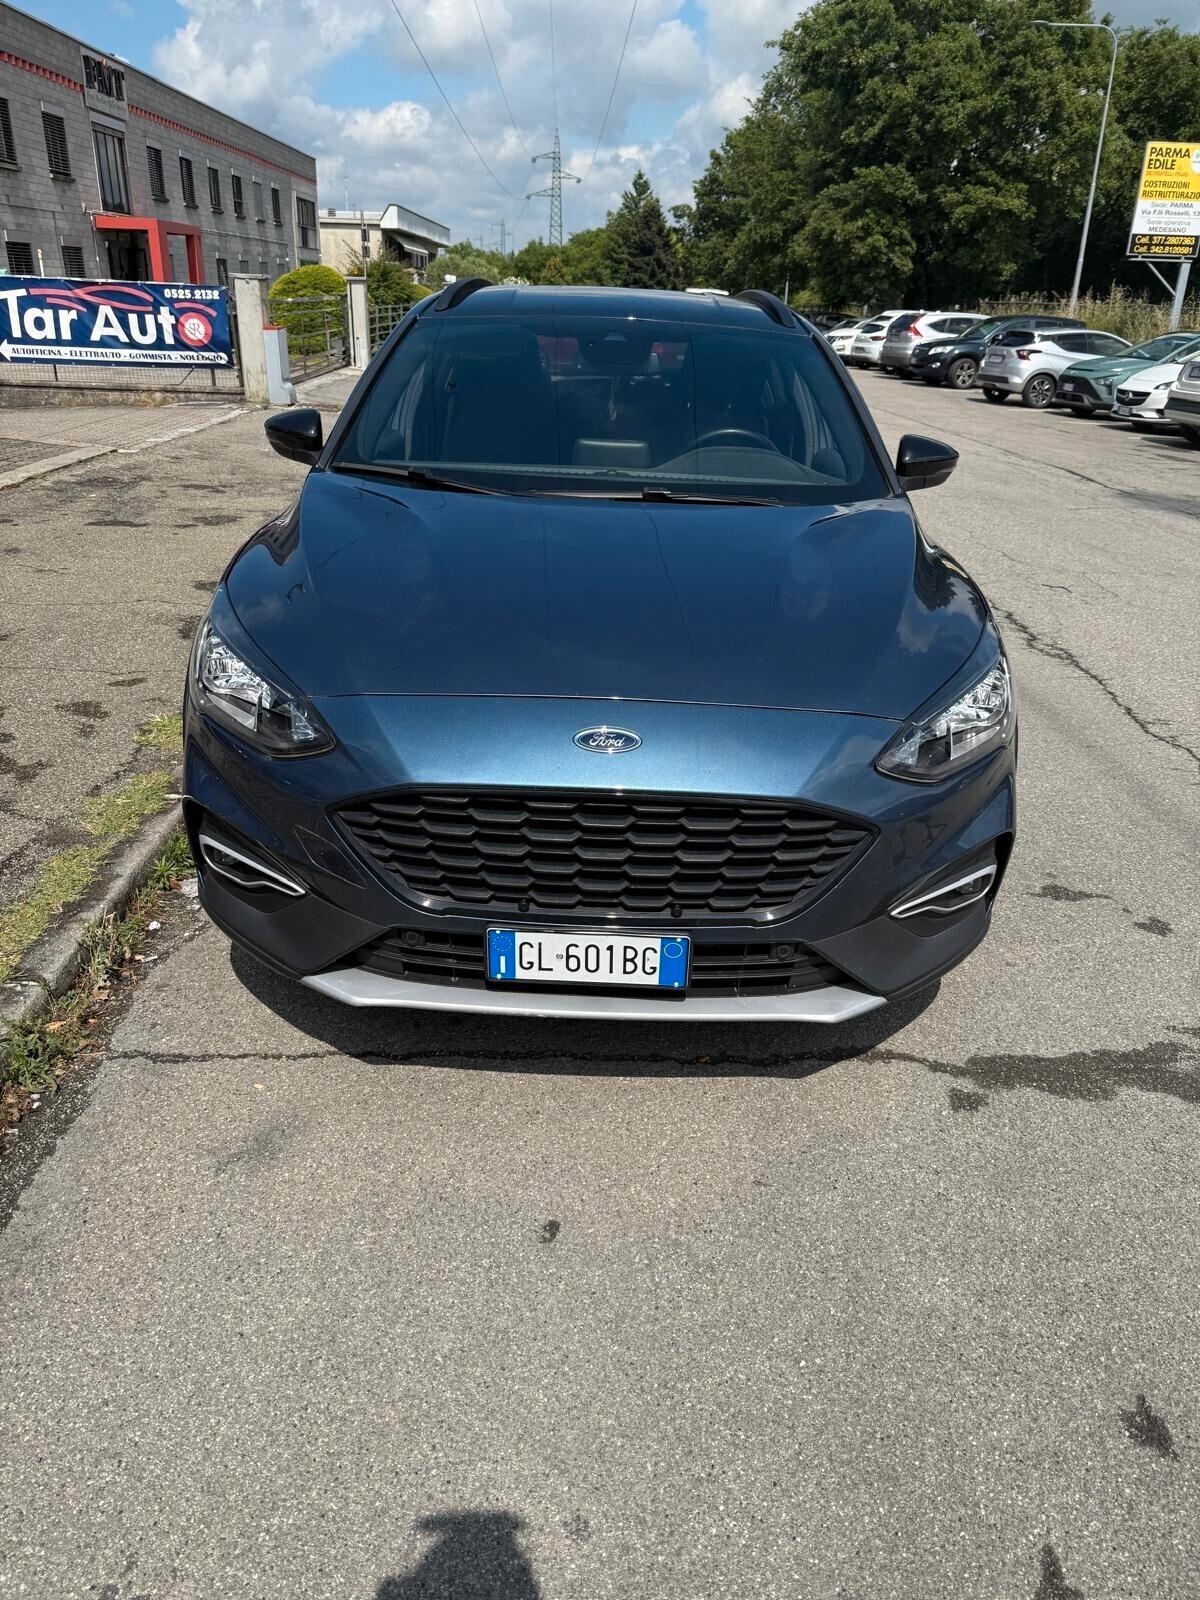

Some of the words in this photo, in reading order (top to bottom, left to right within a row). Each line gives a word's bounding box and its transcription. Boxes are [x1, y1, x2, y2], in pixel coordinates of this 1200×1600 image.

[1149, 147, 1191, 159] PARMA
[1147, 159, 1177, 170] EDILE
[1143, 180, 1191, 189] COSTRUZIONI
[0, 289, 78, 341] Tar
[11, 347, 62, 357] AUTOFFICINA
[69, 349, 121, 359] ELETTRAUTO
[129, 352, 173, 361] GOMMISTA
[589, 733, 626, 747] Ford
